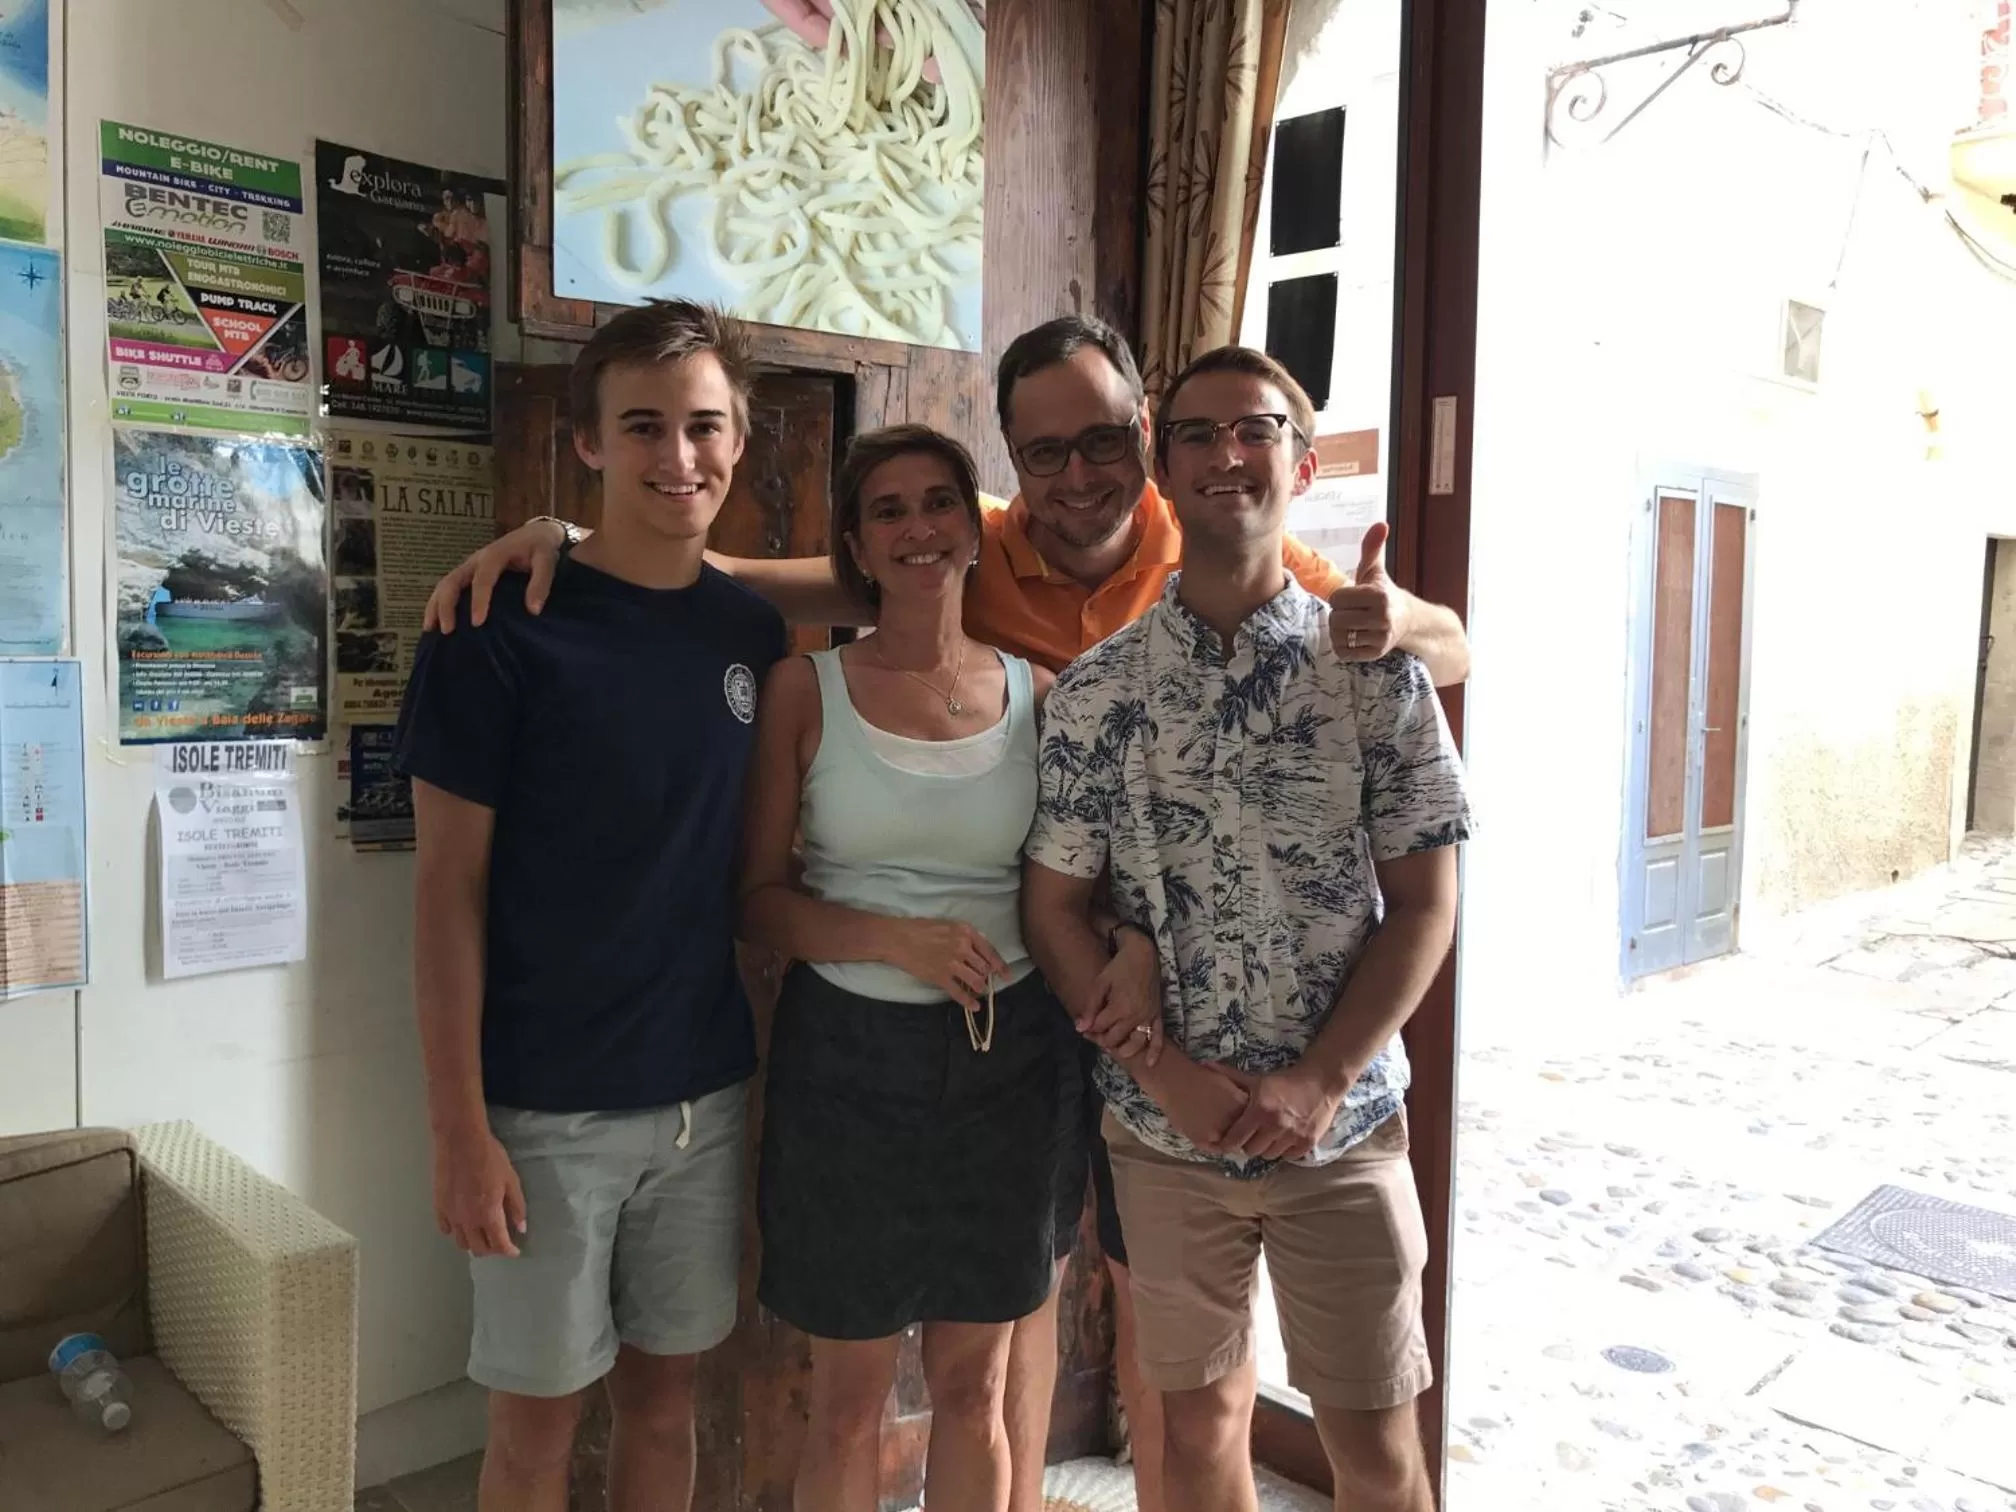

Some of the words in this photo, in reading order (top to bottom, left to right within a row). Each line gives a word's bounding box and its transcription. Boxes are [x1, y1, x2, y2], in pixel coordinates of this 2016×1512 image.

[118, 127, 280, 173] NOLEGGIO/RENT
[170, 156, 233, 180] E-BIKE
[116, 164, 170, 184] MOUNTAIN
[173, 177, 197, 189] BIKE
[208, 183, 231, 195] CITY
[242, 191, 291, 208] TREKKING
[124, 182, 248, 221] BENTEC
[267, 248, 298, 260] BOSCH
[187, 259, 217, 273] TOUR
[219, 263, 240, 276] MTB
[187, 272, 287, 296] ENOGASTRONOMICI
[201, 293, 235, 306] PUMP
[237, 298, 278, 314] TRACK
[212, 317, 262, 333] SCHOOL
[224, 329, 250, 341] MTB
[115, 347, 146, 360] BIKE
[149, 351, 203, 366] SHUTTLE
[159, 453, 181, 475] le
[127, 471, 235, 499] grotte
[148, 491, 236, 513] marine
[380, 485, 412, 513] LA
[161, 508, 188, 531] di
[197, 511, 281, 536] Vieste
[172, 745, 220, 773] ISOLE
[224, 744, 288, 771] TREMITI
[177, 828, 218, 843] ISOLE
[223, 825, 284, 840] TREMITI
